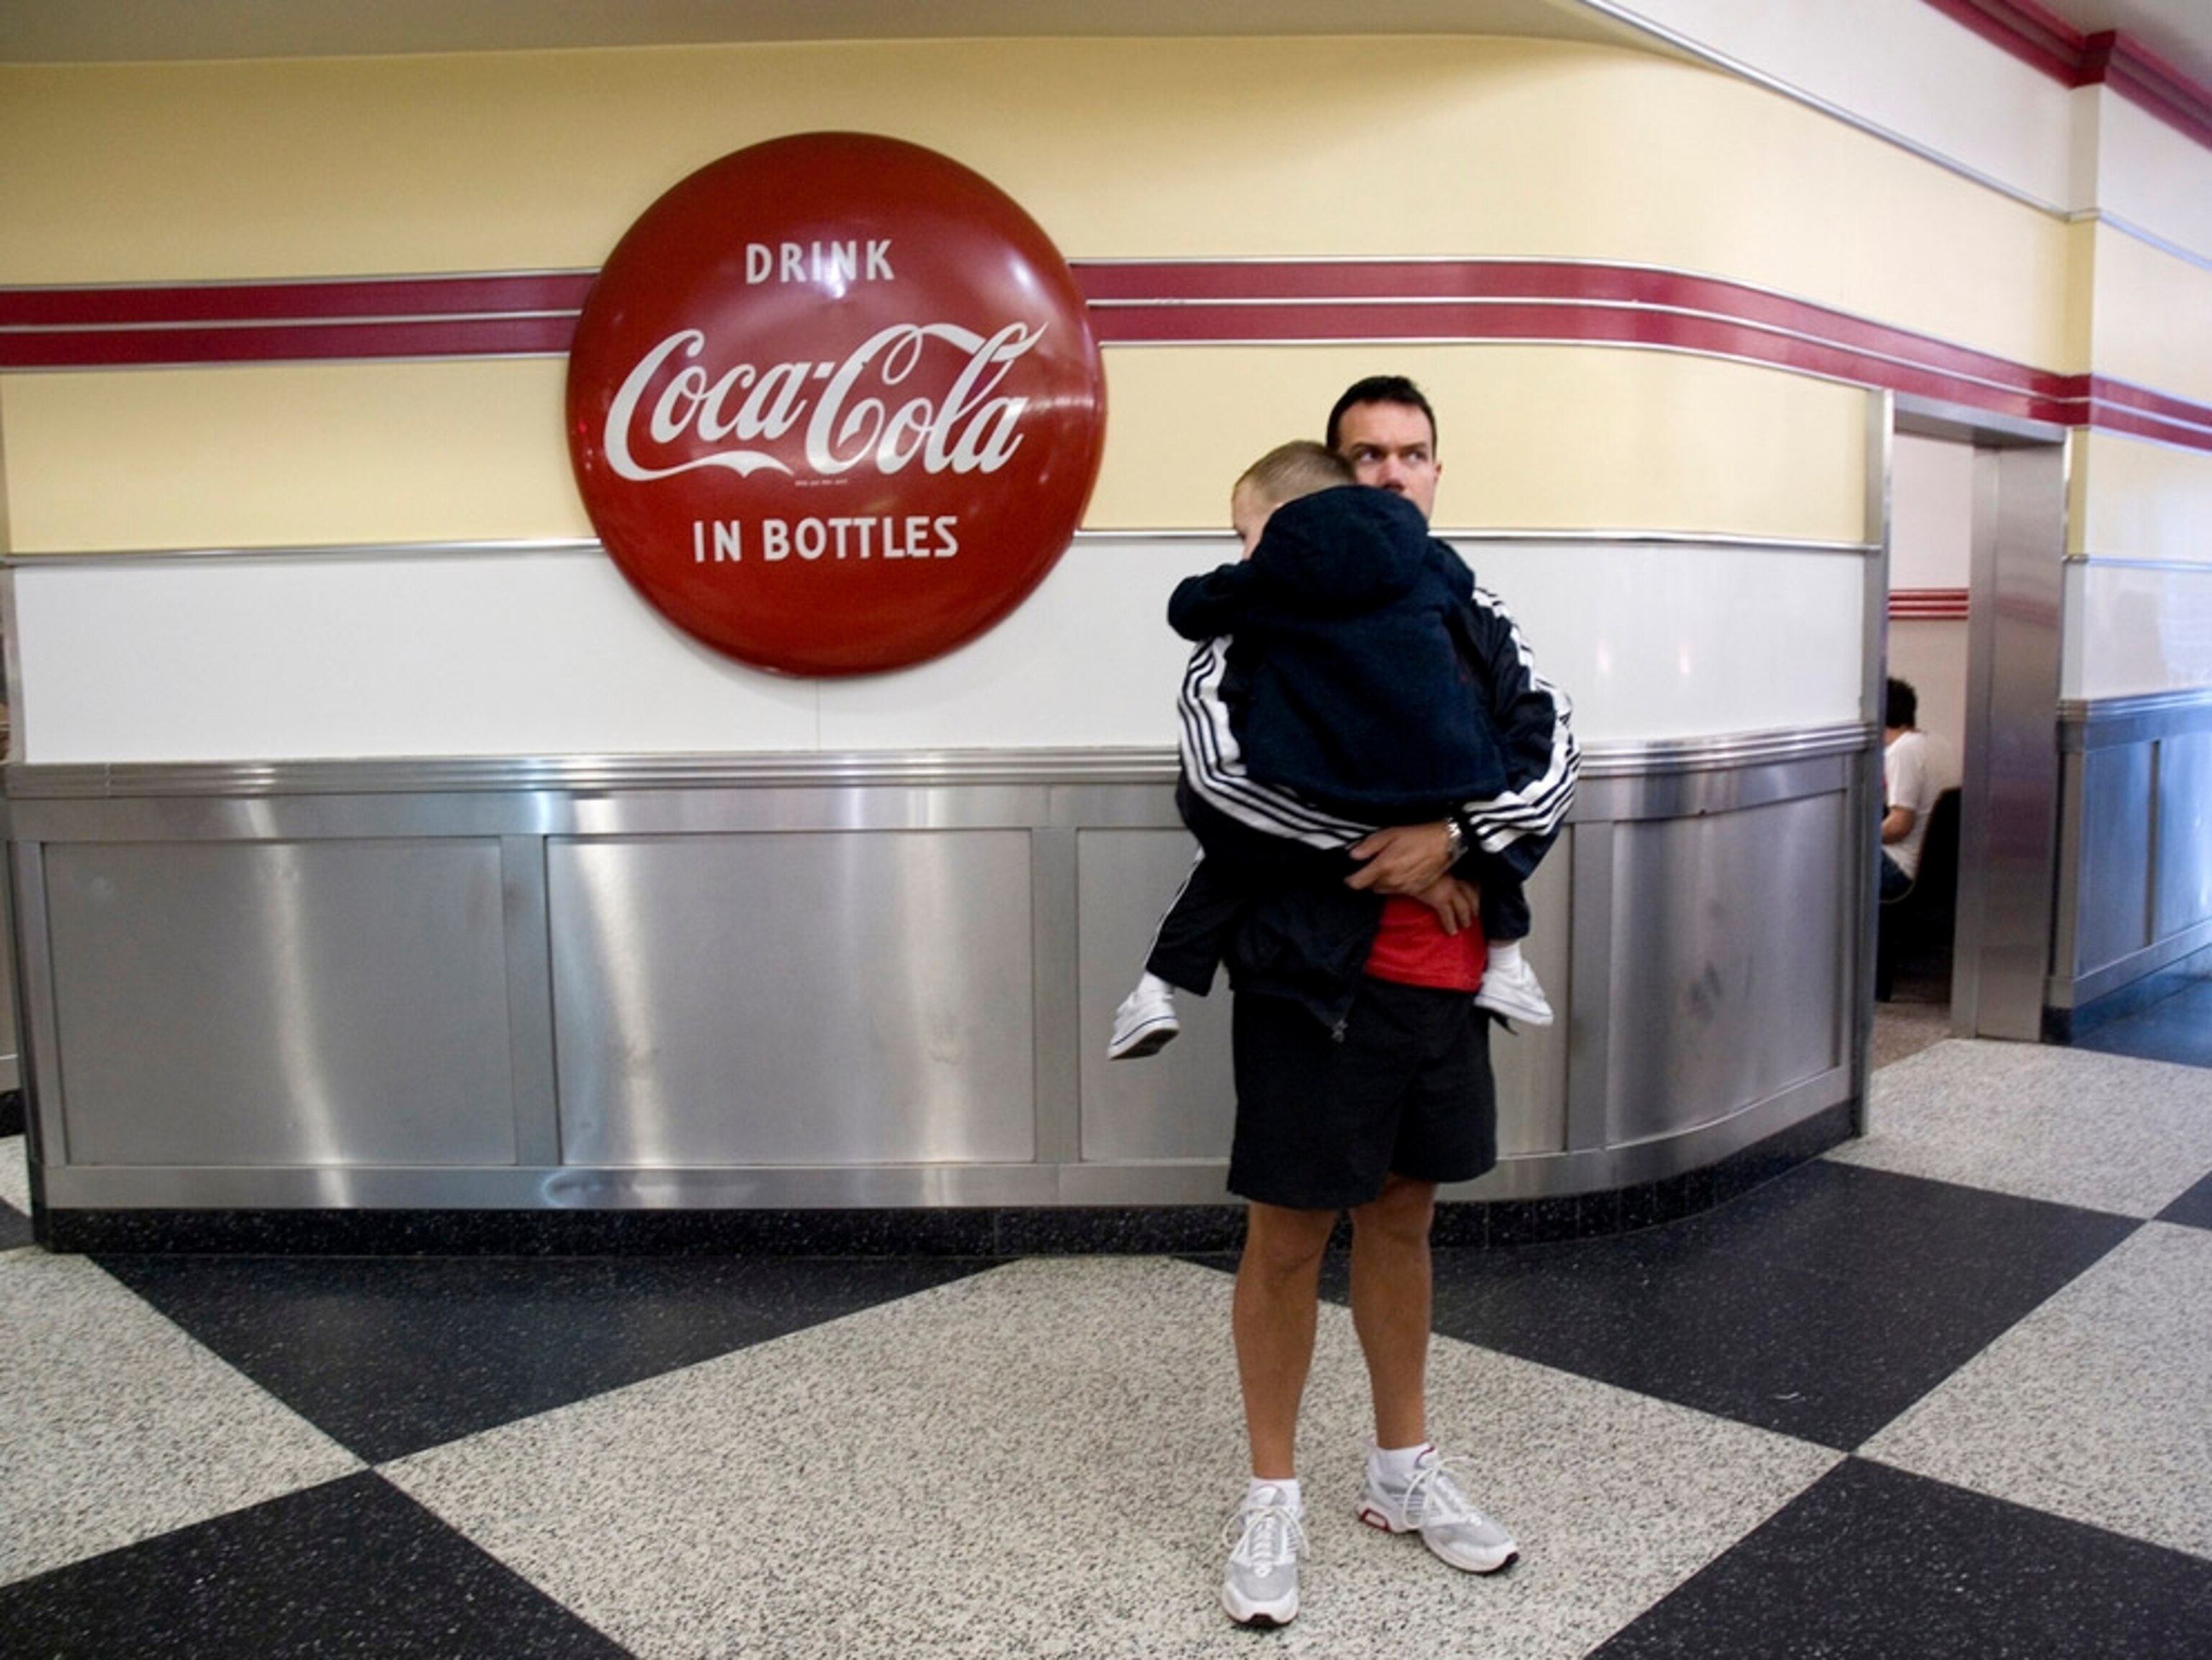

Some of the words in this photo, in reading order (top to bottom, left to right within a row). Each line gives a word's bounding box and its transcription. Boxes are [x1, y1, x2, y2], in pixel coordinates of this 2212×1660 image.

[745, 239, 894, 284] DRINK
[603, 322, 1049, 481] Coca-Cola
[693, 520, 742, 563] IN
[763, 515, 959, 561] BOTTLES
